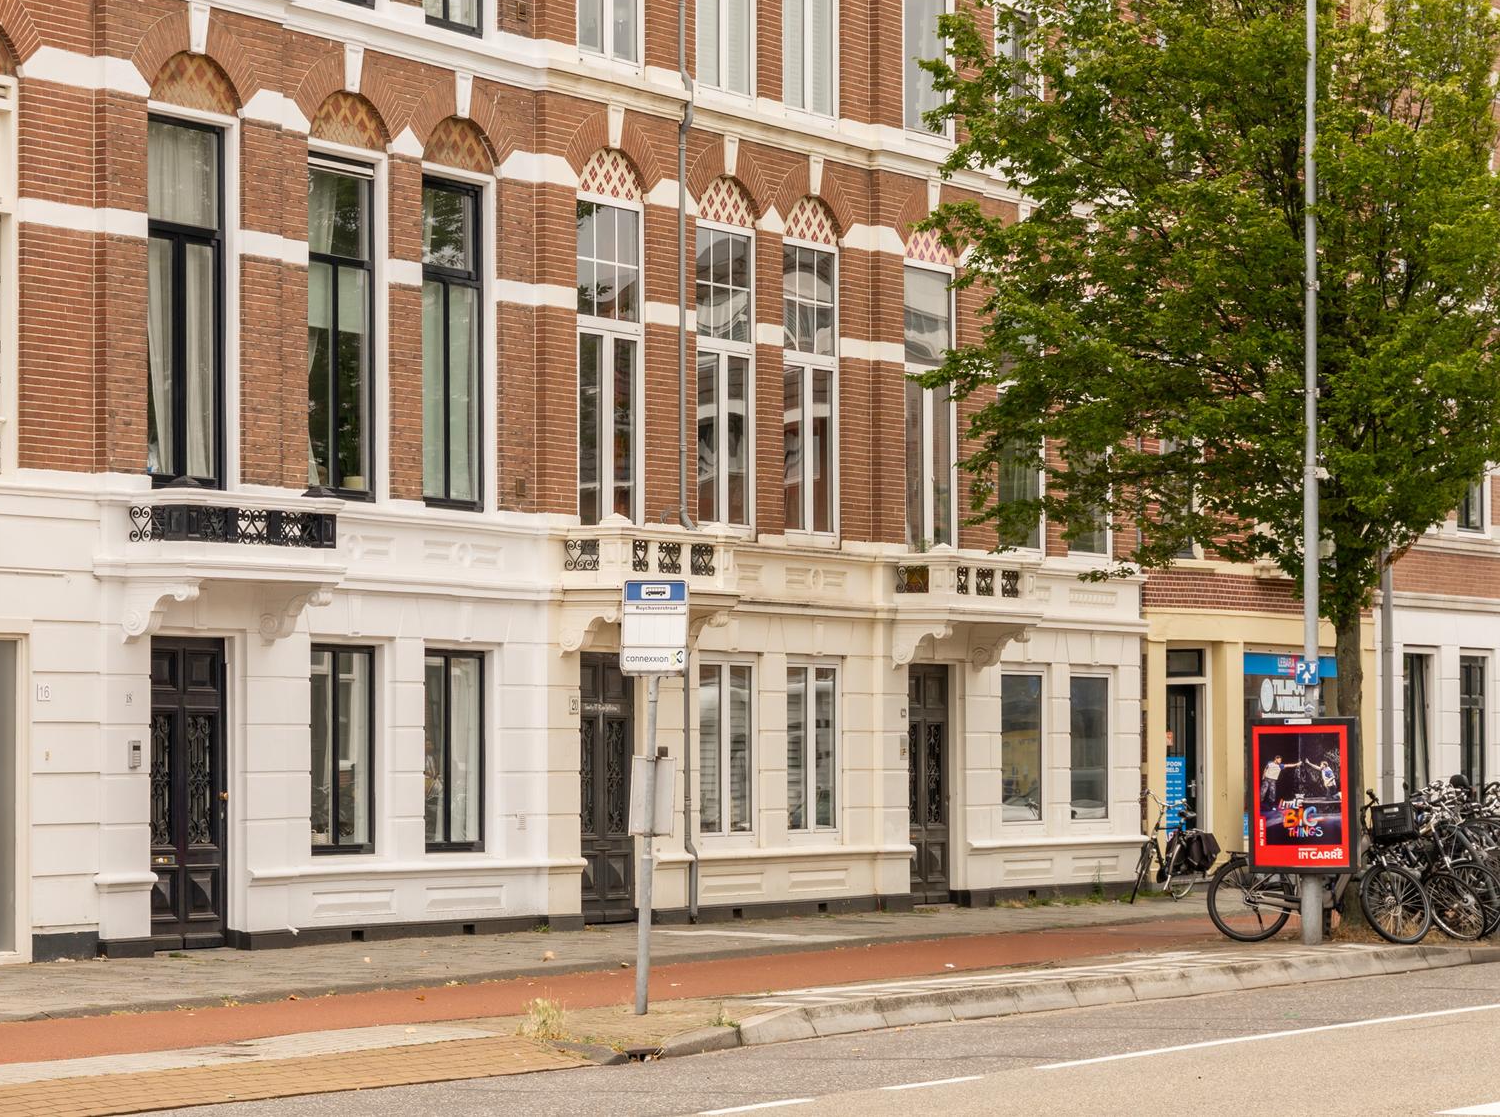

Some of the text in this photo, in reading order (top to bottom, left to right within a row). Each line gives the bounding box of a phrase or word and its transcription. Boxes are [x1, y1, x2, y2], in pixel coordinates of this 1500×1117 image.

[625, 655, 669, 663] connexxion
[1297, 663, 1306, 674] P
[39, 685, 51, 700] 16
[571, 698, 579, 711] 20
[1283, 806, 1319, 828] BIG
[1287, 826, 1324, 838] THINGS
[1298, 851, 1309, 860] IN
